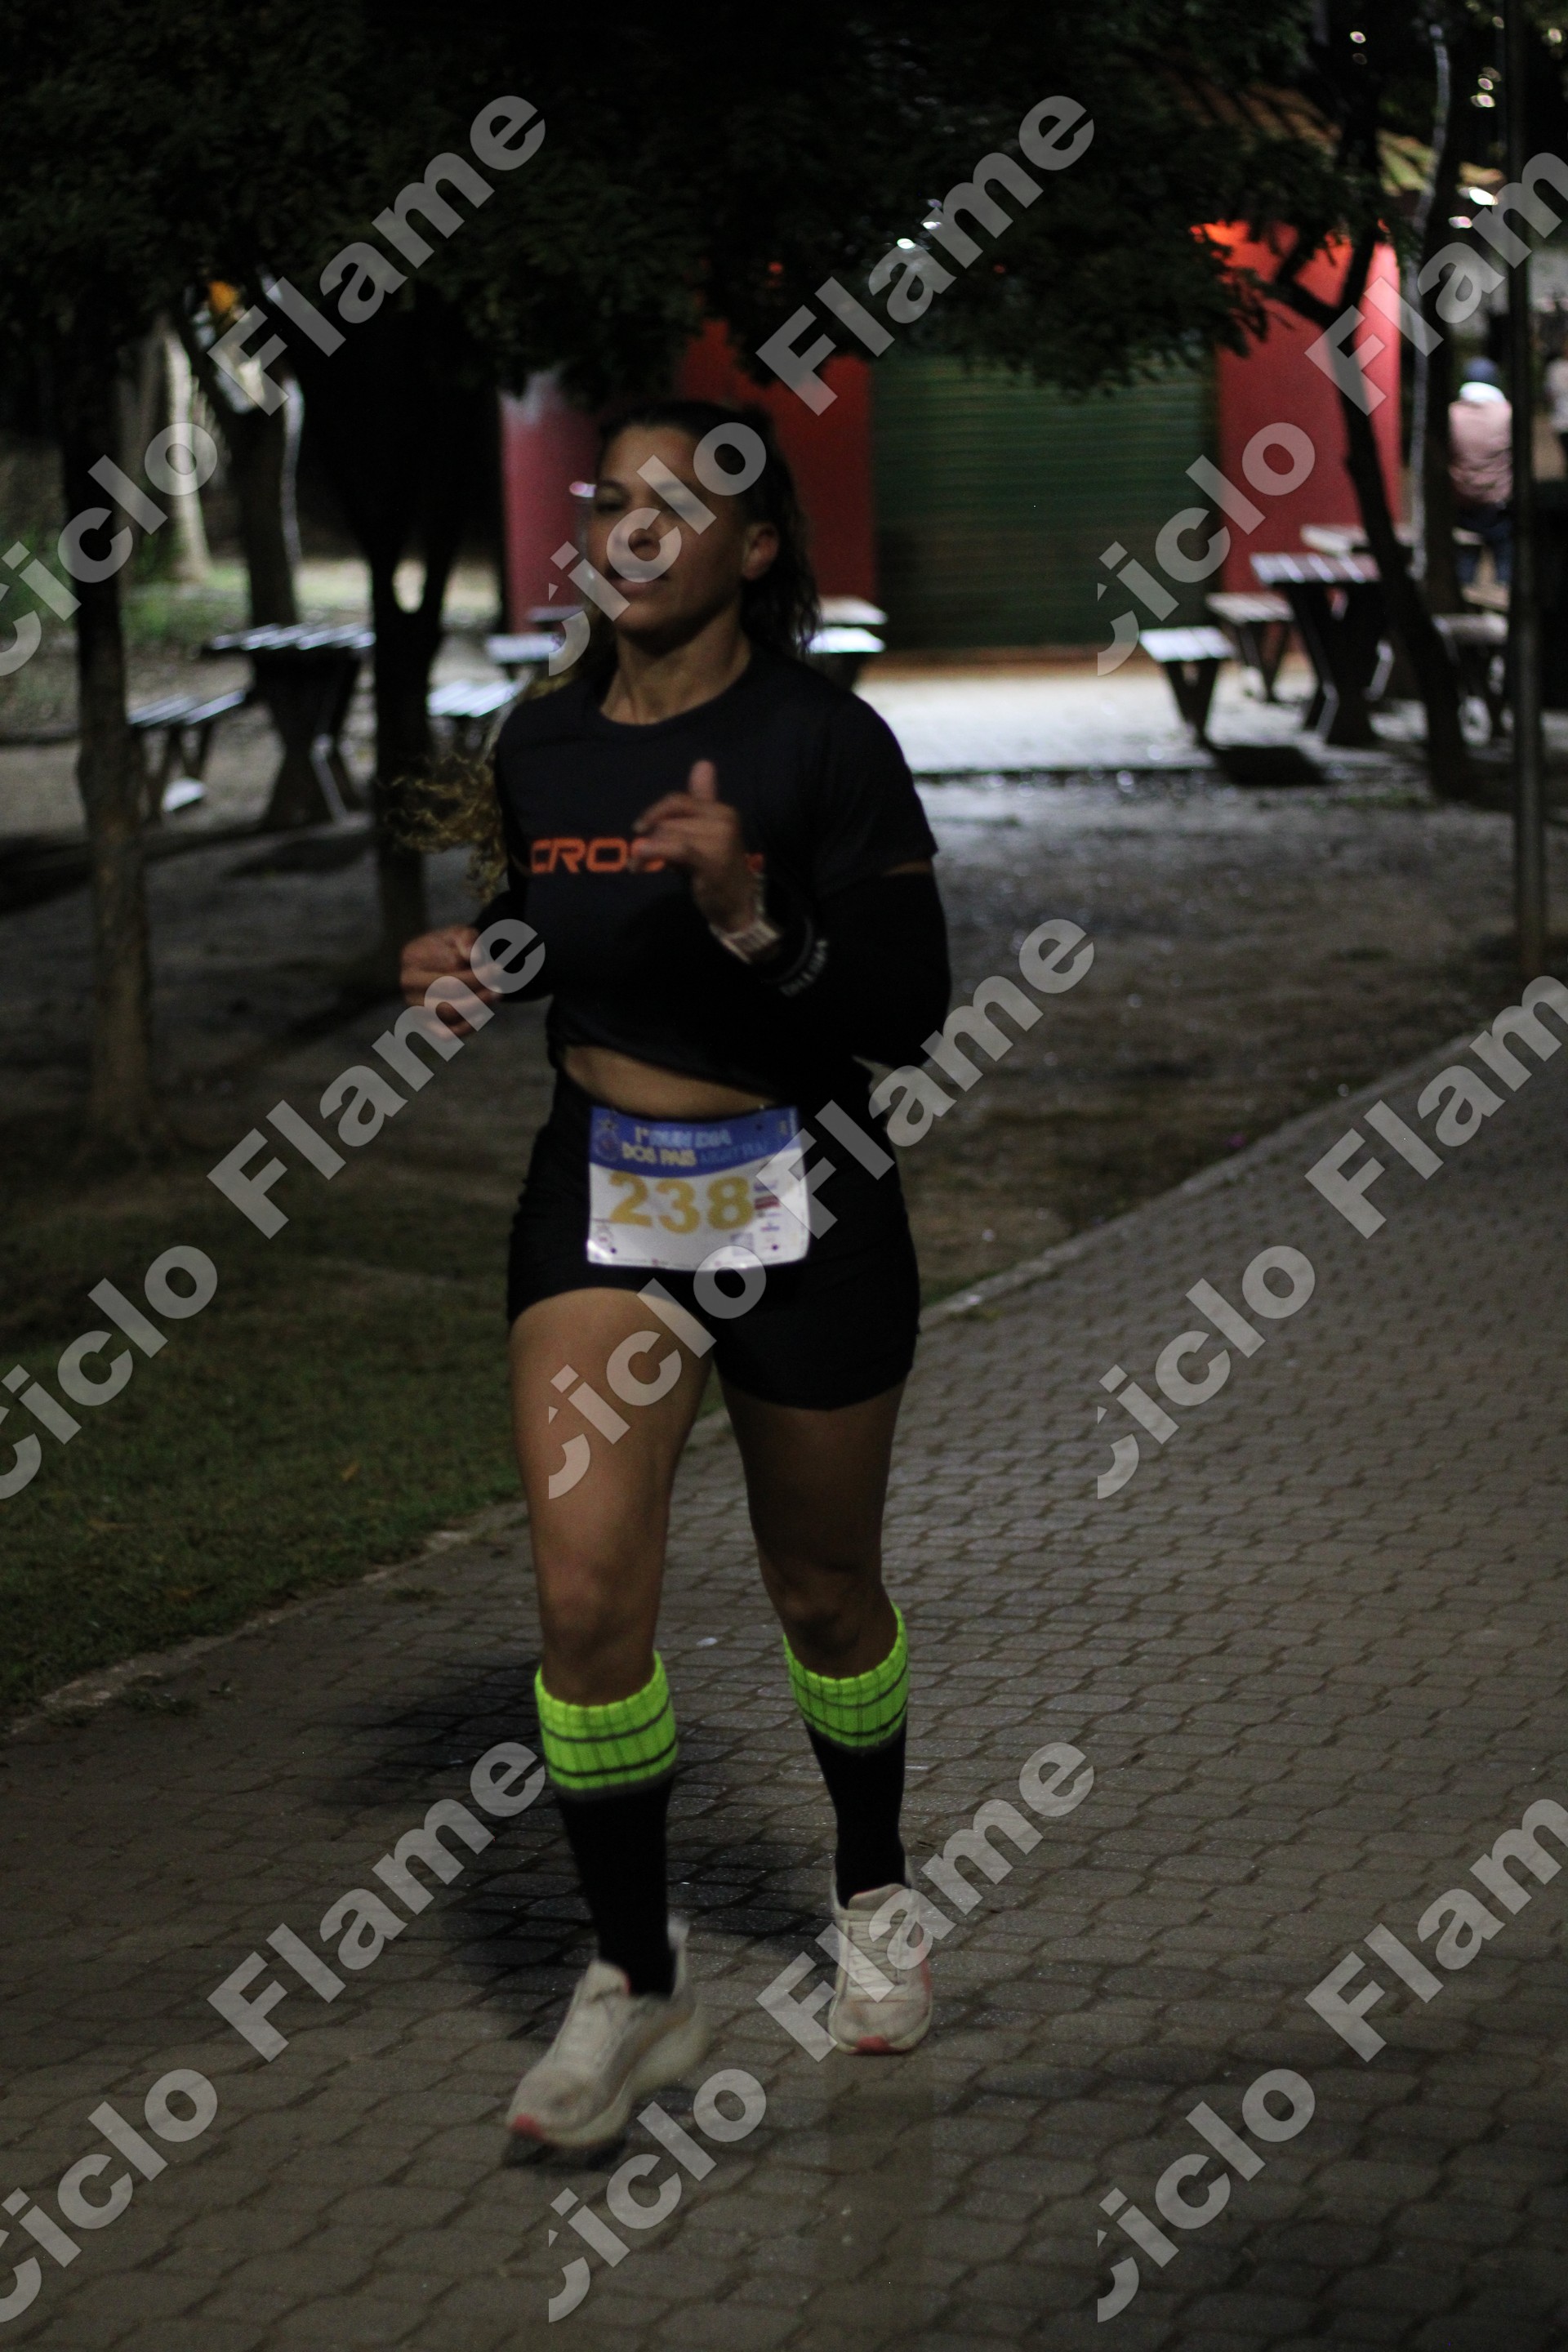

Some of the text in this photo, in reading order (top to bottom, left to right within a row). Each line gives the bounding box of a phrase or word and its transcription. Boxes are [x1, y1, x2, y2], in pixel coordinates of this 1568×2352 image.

[621, 1142, 657, 1165] DOS
[660, 1148, 697, 1167] PAIS
[608, 1171, 754, 1235] 238
